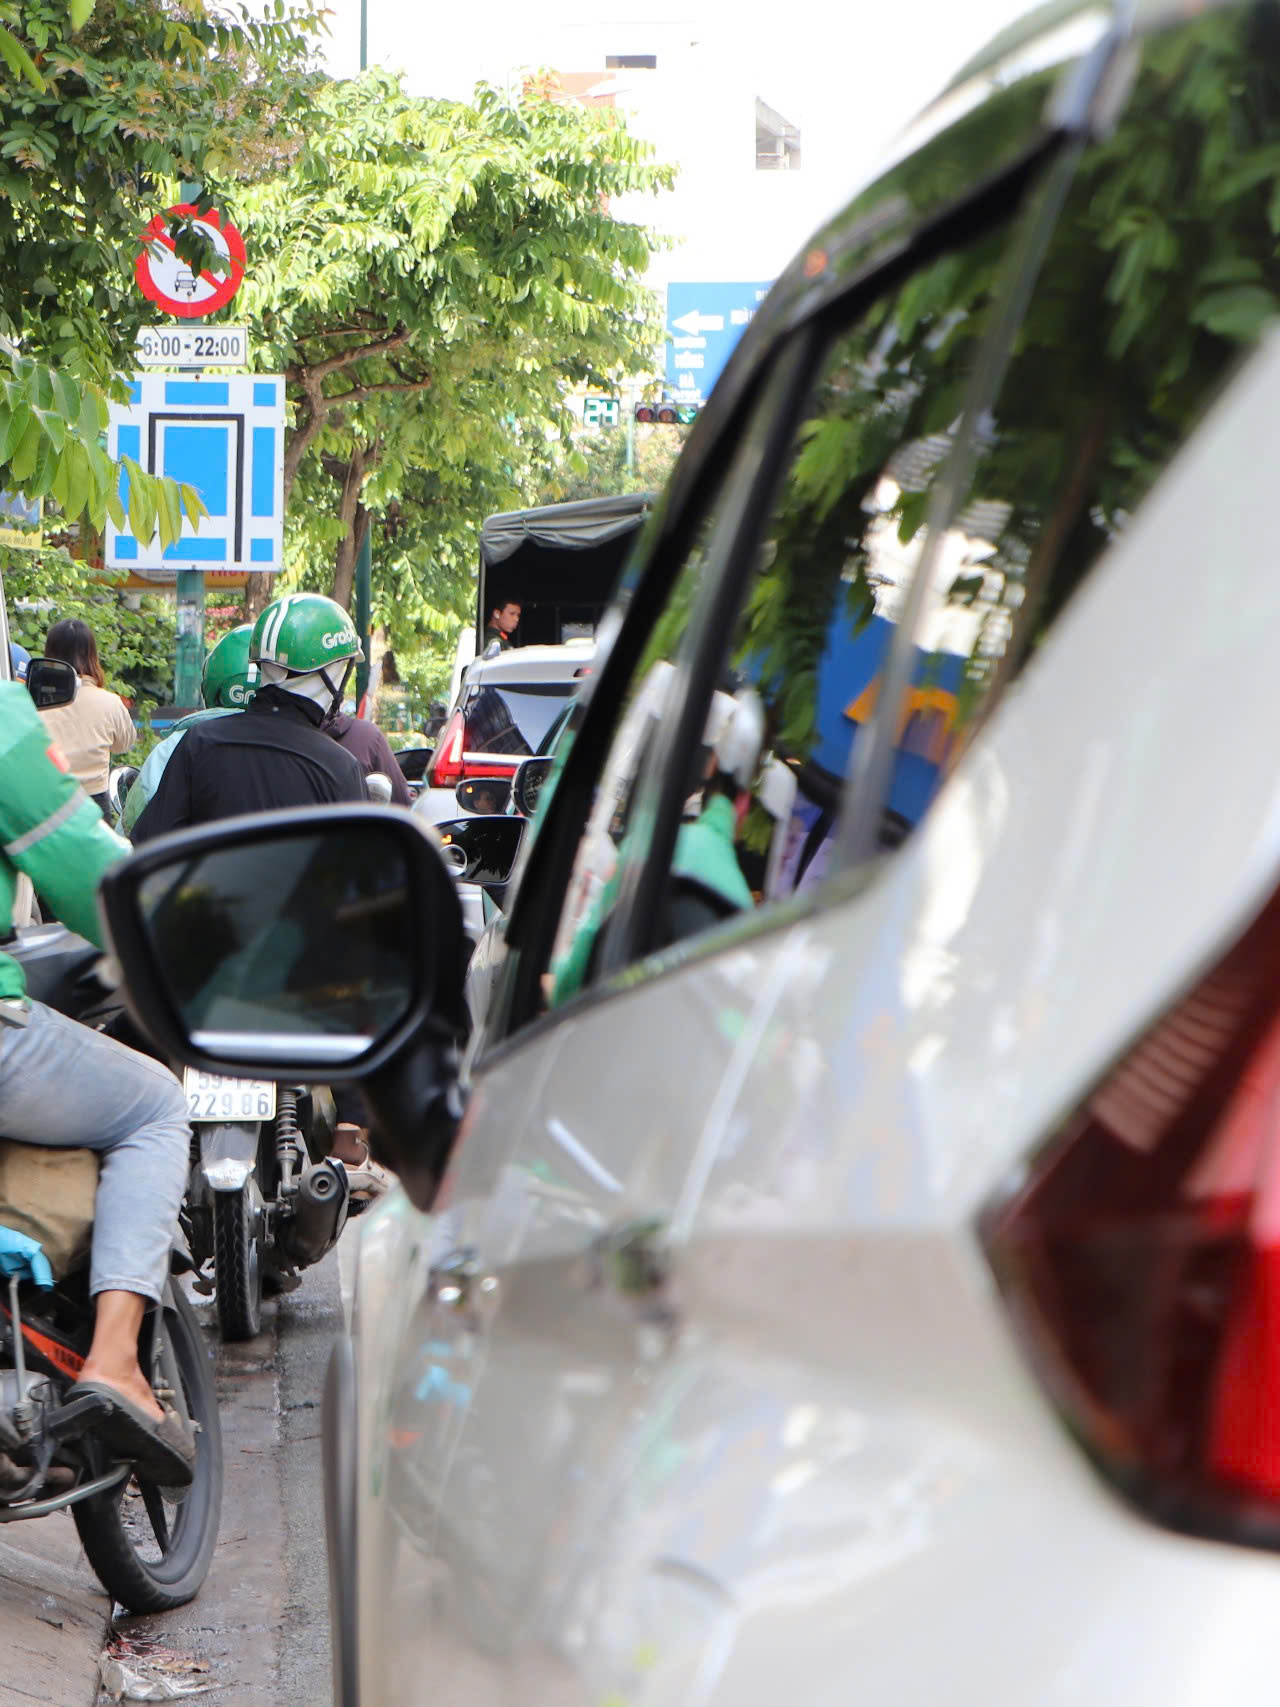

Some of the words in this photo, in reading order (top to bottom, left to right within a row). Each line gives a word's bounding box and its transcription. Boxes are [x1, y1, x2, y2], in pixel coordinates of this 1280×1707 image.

[195, 336, 240, 356] 22:00
[584, 399, 619, 427] 24
[229, 684, 257, 705] Gr
